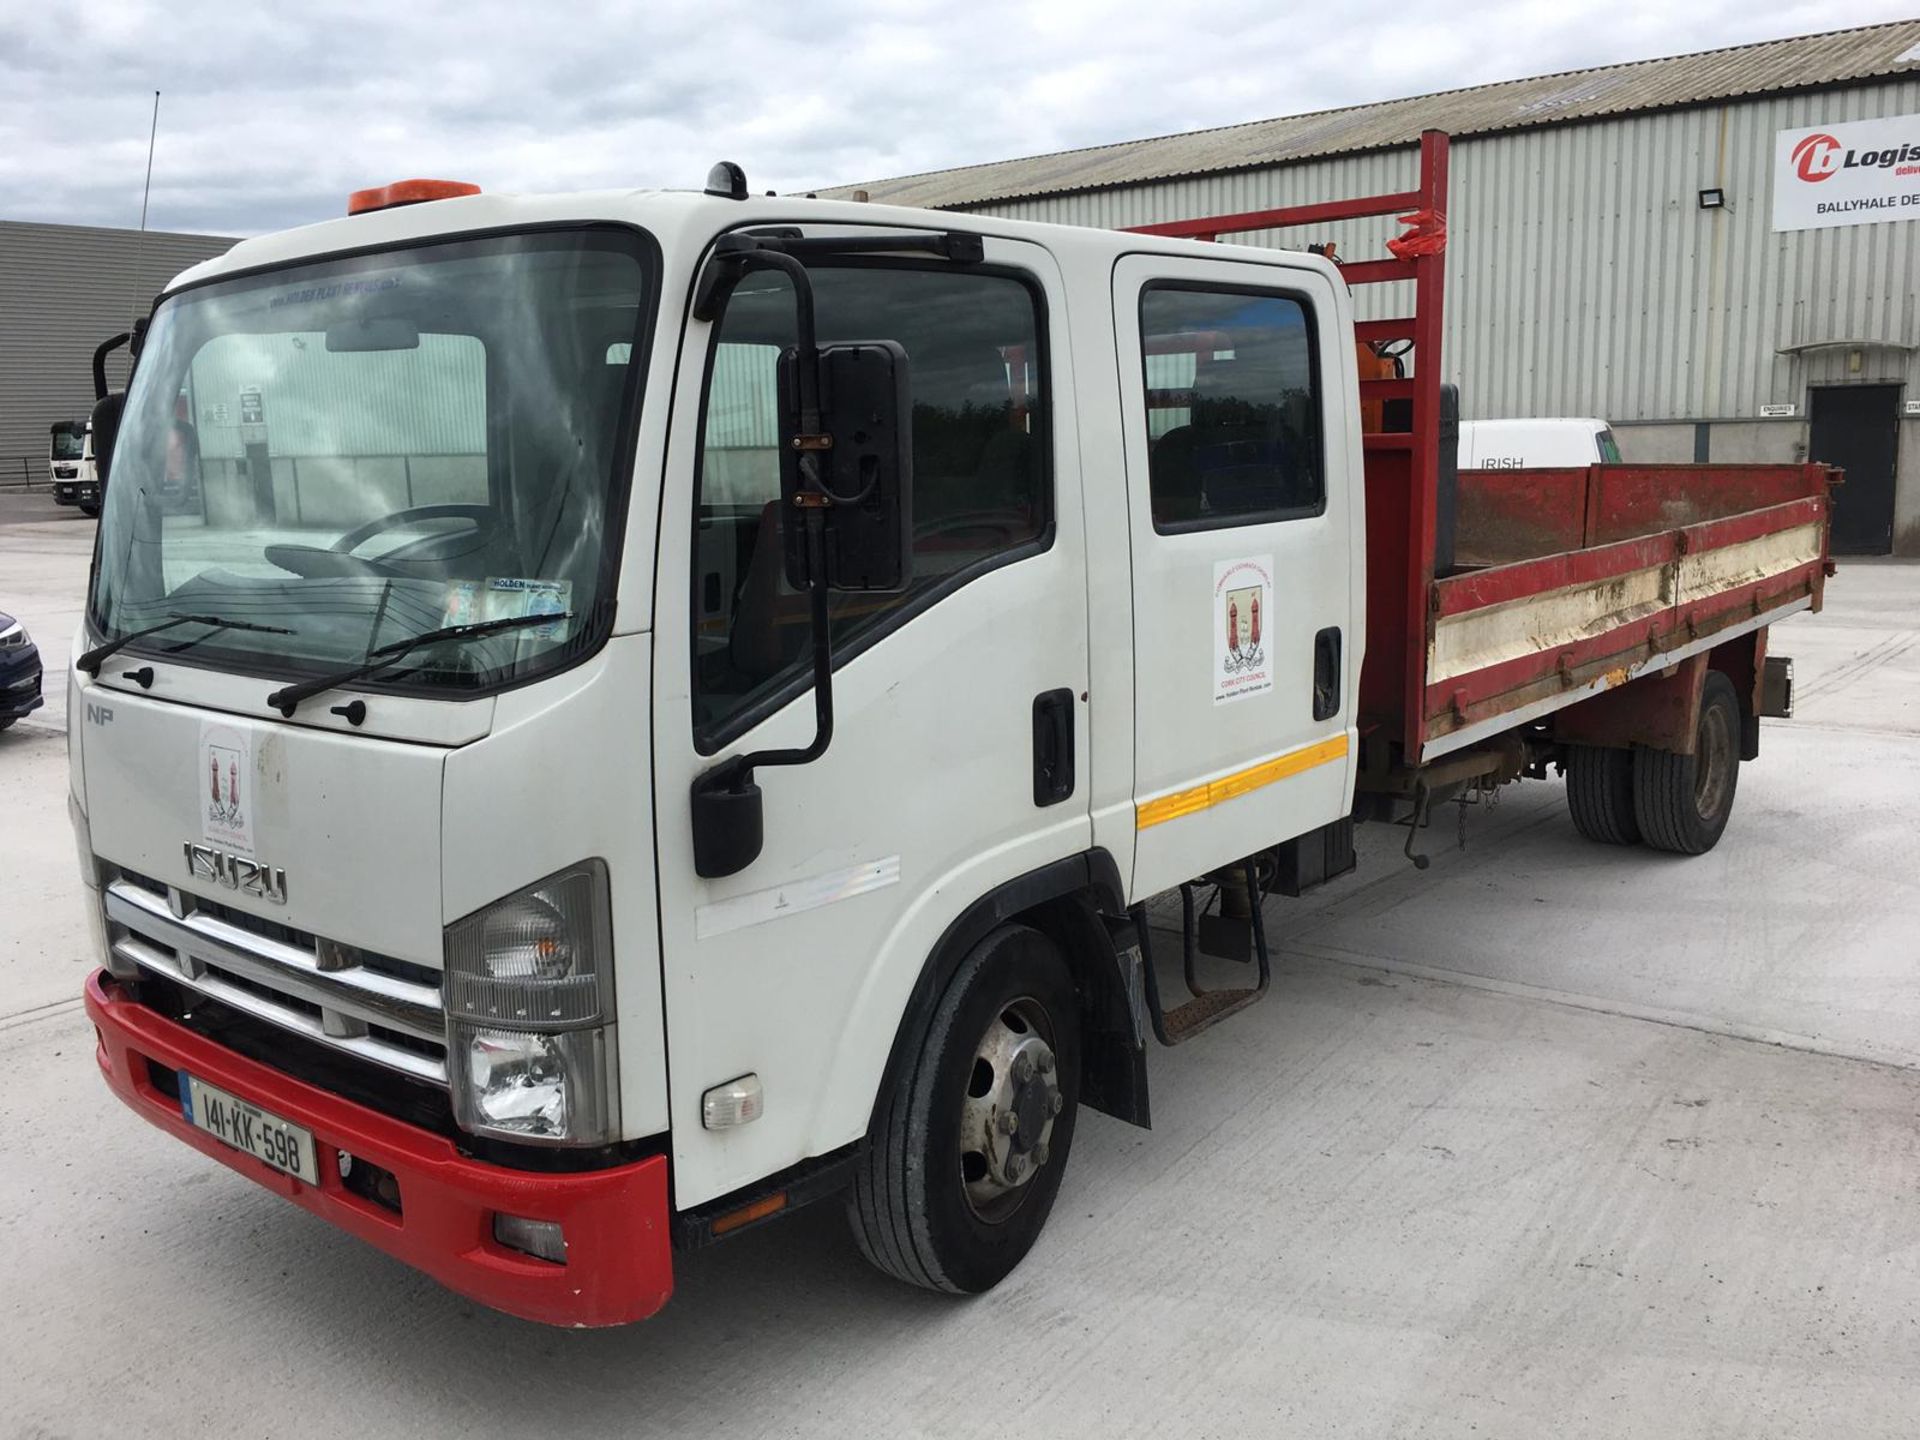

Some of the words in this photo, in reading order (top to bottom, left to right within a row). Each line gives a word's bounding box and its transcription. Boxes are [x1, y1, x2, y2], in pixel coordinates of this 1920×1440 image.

[1843, 143, 1920, 168] Logis
[1895, 165, 1920, 176] deliv
[1817, 196, 1896, 214] BALLYHALE
[1481, 457, 1524, 469] IRISH
[494, 579, 525, 588] HOLDEN
[87, 703, 114, 726] NP
[183, 840, 289, 906] ISUZU
[203, 1093, 301, 1174] 141-KK-598
